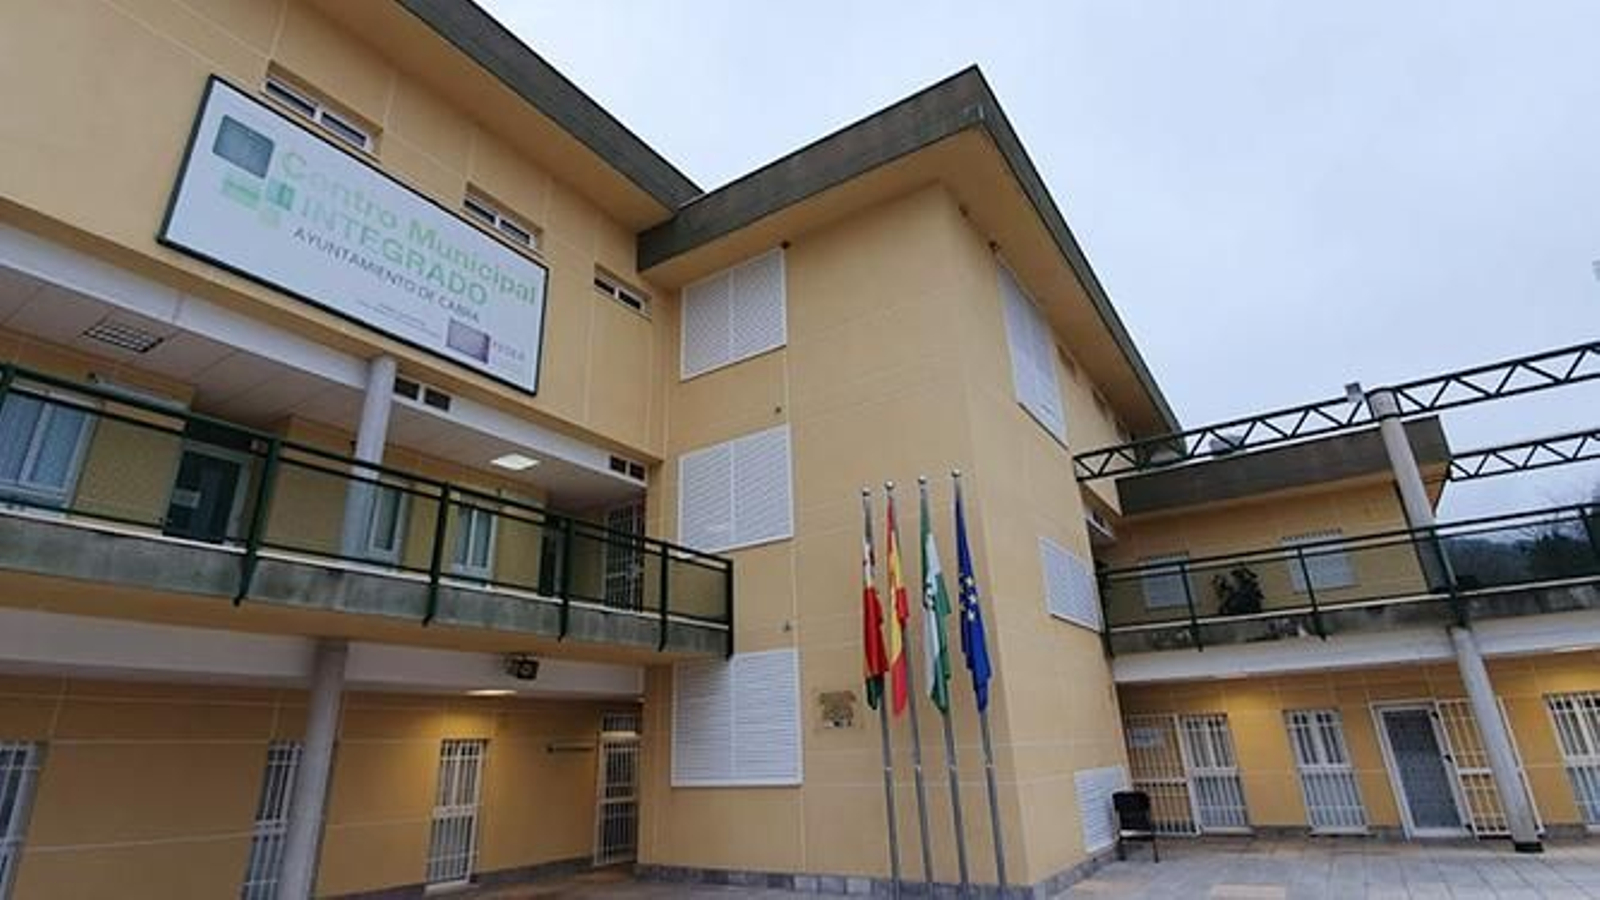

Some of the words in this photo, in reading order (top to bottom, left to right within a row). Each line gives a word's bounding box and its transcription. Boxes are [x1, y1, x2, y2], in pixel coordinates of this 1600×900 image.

[291, 227, 416, 293] AYUNTAMIENTO
[301, 197, 487, 305] INTEGRADO
[408, 218, 536, 305] Municipal
